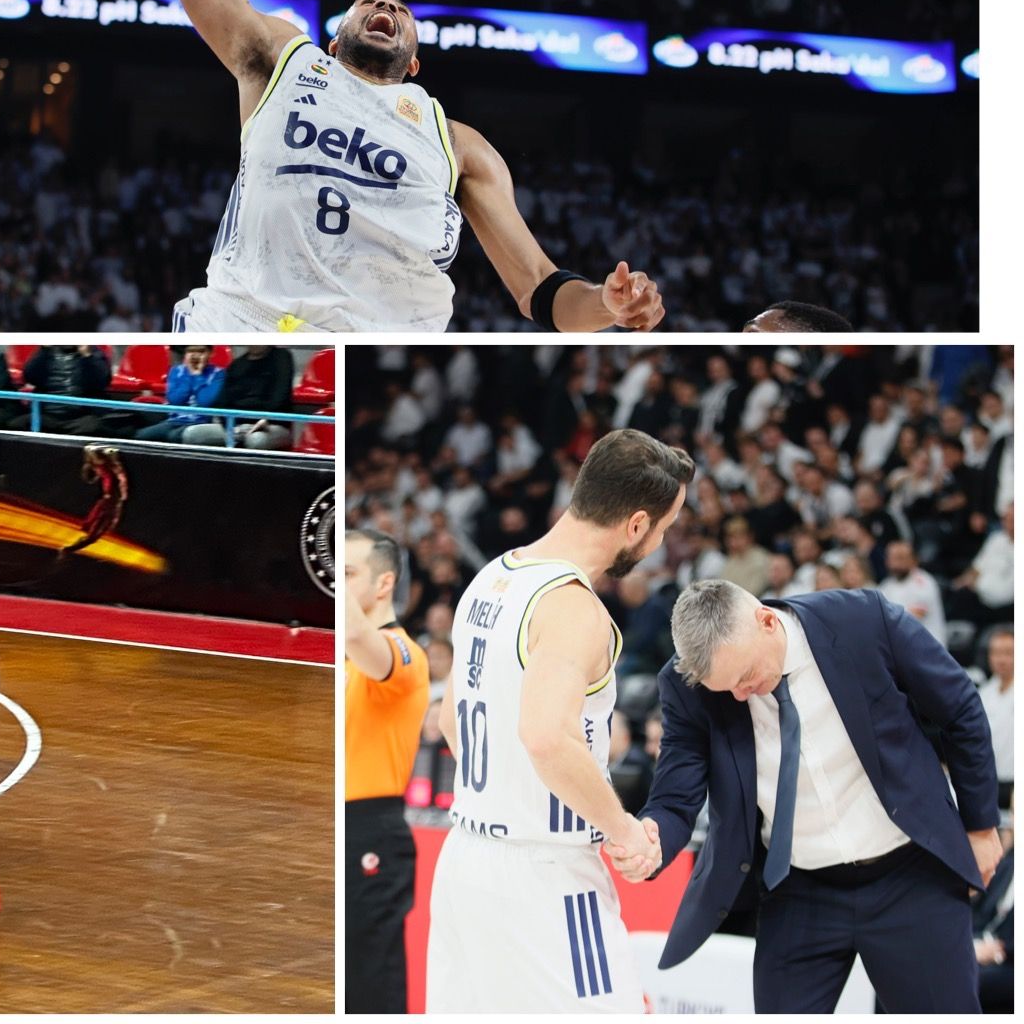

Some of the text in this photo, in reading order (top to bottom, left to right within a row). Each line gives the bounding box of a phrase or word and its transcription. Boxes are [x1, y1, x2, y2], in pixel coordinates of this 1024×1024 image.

[297, 73, 329, 88] beko
[283, 111, 408, 180] beko
[316, 186, 351, 235] 8
[457, 698, 488, 793] 10
